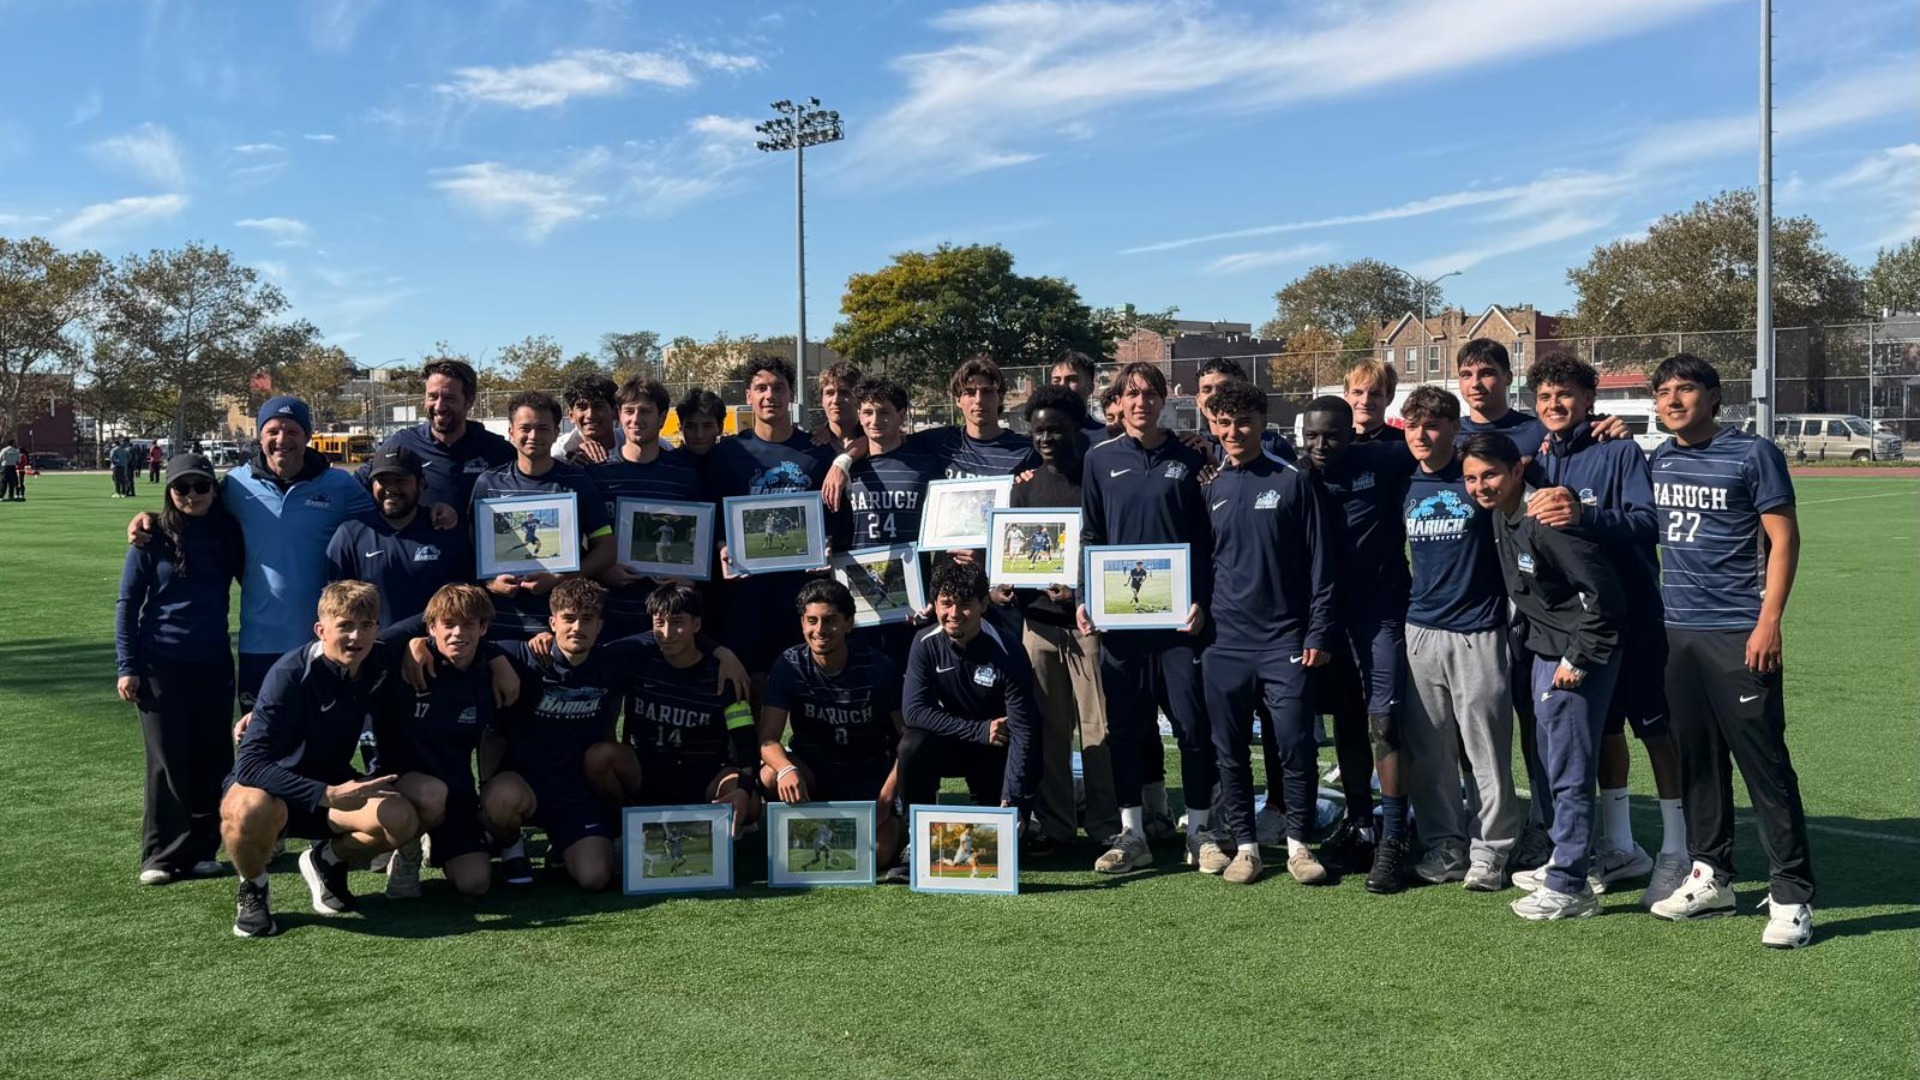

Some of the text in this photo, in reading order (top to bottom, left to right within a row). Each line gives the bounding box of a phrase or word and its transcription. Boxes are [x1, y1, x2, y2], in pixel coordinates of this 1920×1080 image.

[867, 513, 897, 539] 24
[1406, 518, 1466, 537] BARUCH
[1667, 511, 1701, 542] 27
[413, 702, 431, 718] 17
[537, 695, 601, 714] BARUCH
[635, 697, 711, 728] BARUCH
[803, 702, 873, 725] BARUCH
[656, 725, 683, 748] 14
